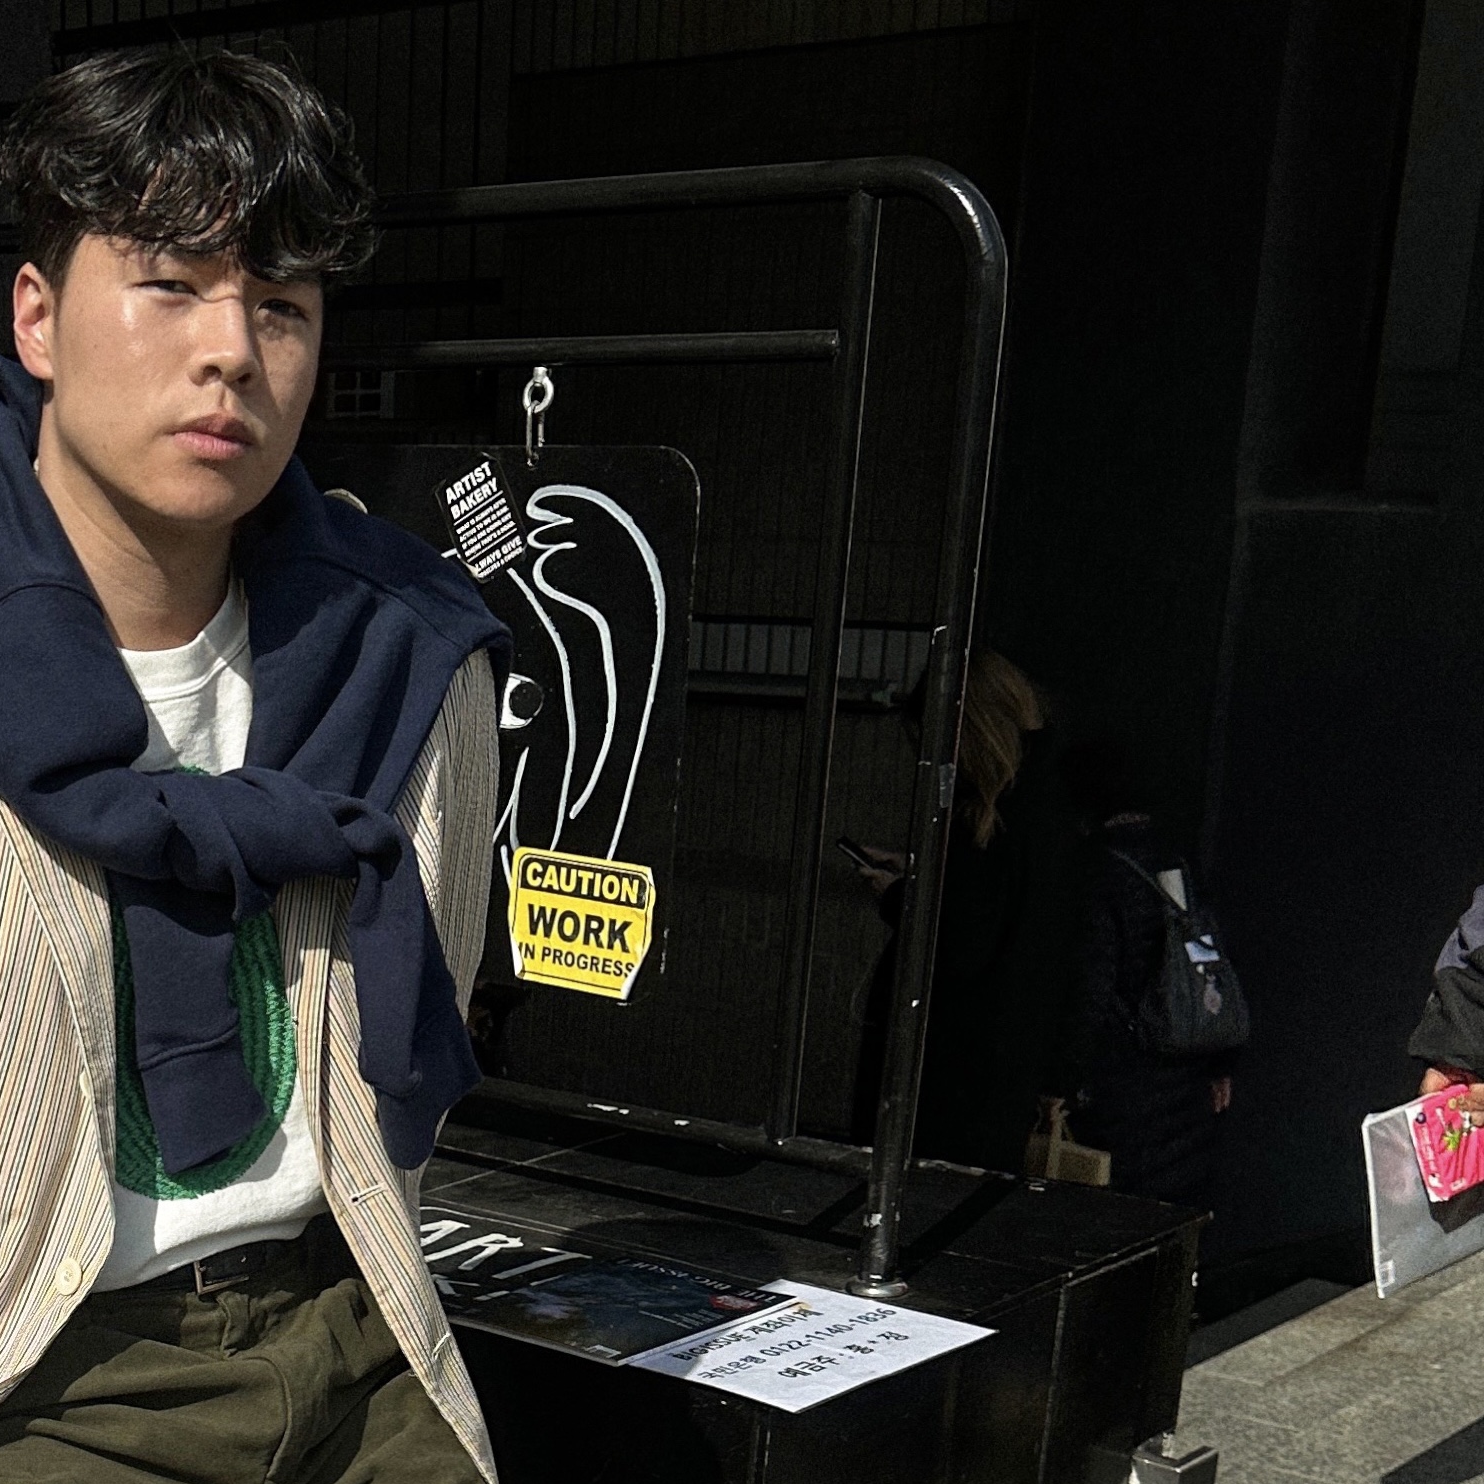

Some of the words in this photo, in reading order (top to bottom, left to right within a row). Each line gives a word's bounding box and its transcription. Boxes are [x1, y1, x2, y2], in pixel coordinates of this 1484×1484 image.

[445, 460, 492, 504] ARTIST
[450, 476, 498, 520] BAKERY
[473, 549, 502, 573] LWAYS
[500, 535, 523, 555] GIVE
[525, 861, 640, 904] CAUTION
[527, 903, 632, 954] WORK
[518, 942, 535, 960] IN
[541, 946, 635, 978] PROGRESS
